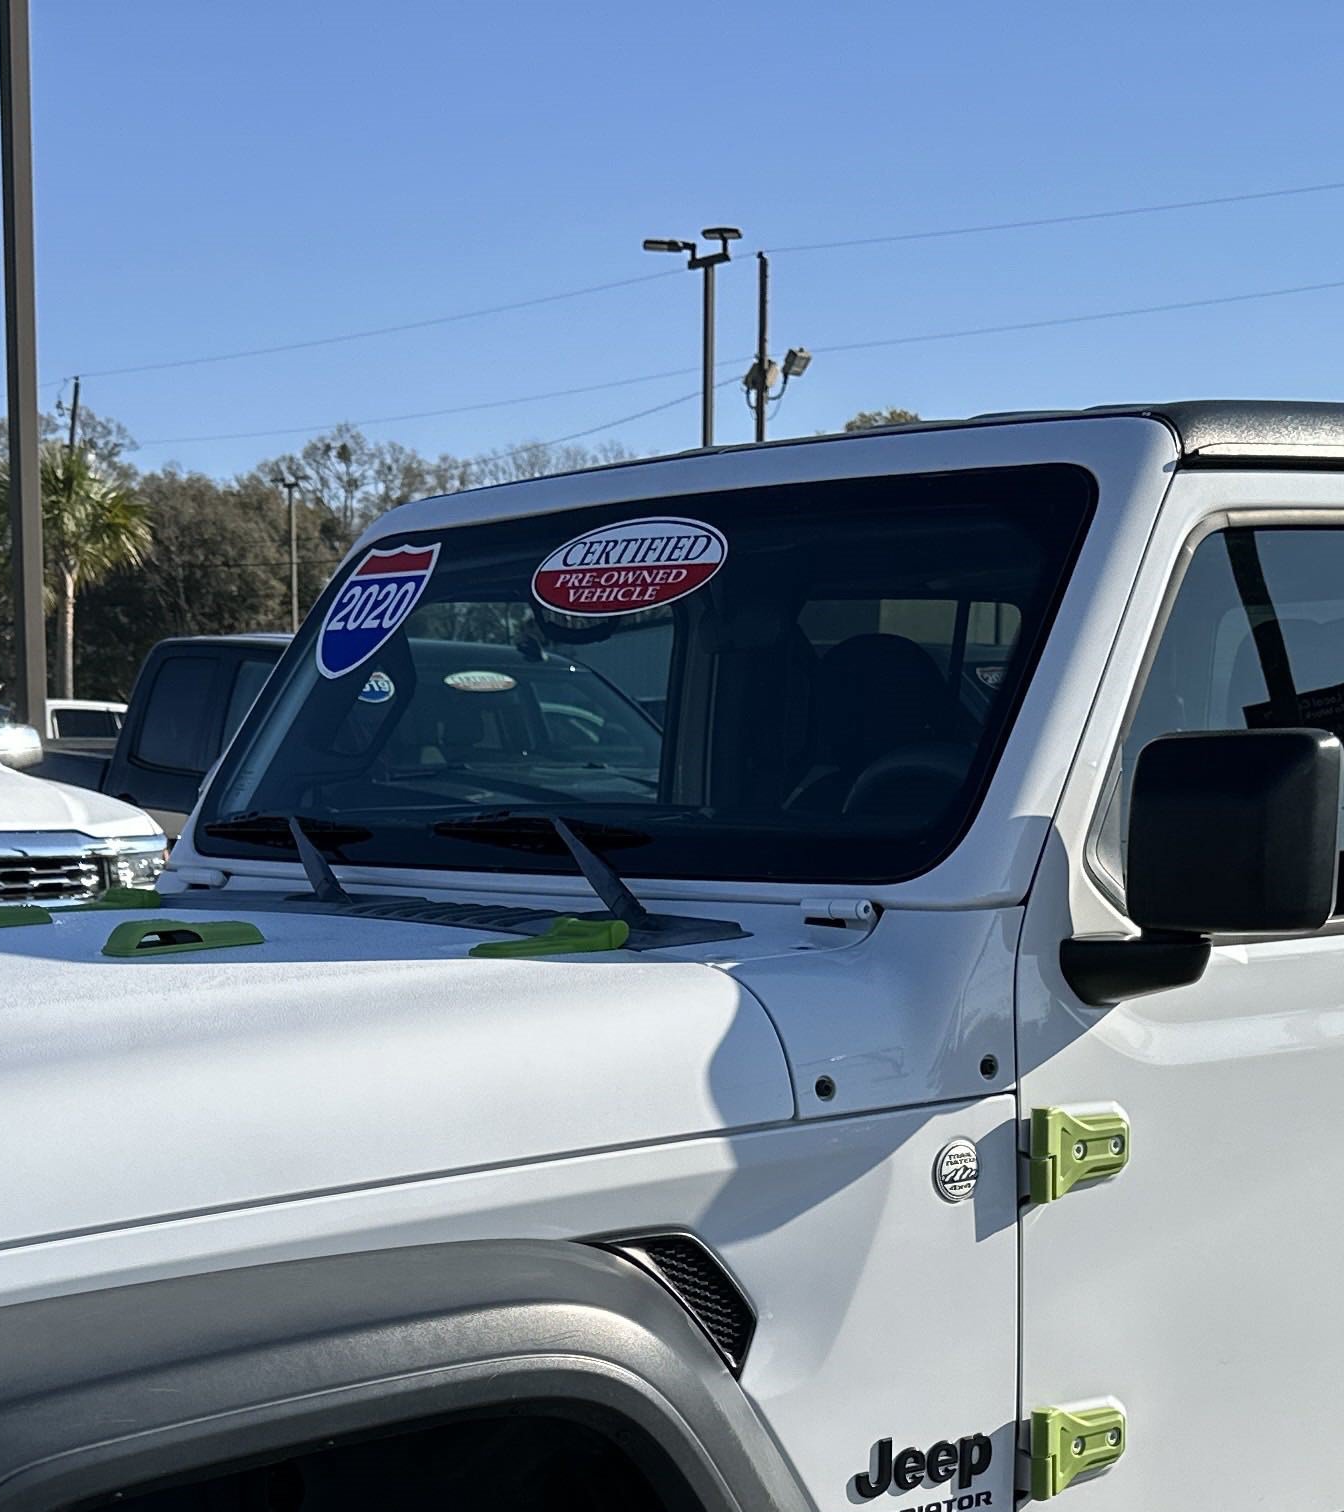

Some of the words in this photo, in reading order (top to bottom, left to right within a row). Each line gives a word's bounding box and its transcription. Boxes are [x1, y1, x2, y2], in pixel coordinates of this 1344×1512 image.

[562, 534, 712, 567] CERTIFIED
[554, 569, 688, 589] PRE-OWNED
[326, 581, 416, 631] 2020
[567, 586, 661, 603] VEHICLE
[945, 1157, 976, 1167] RATED
[854, 1431, 993, 1500] Jeep
